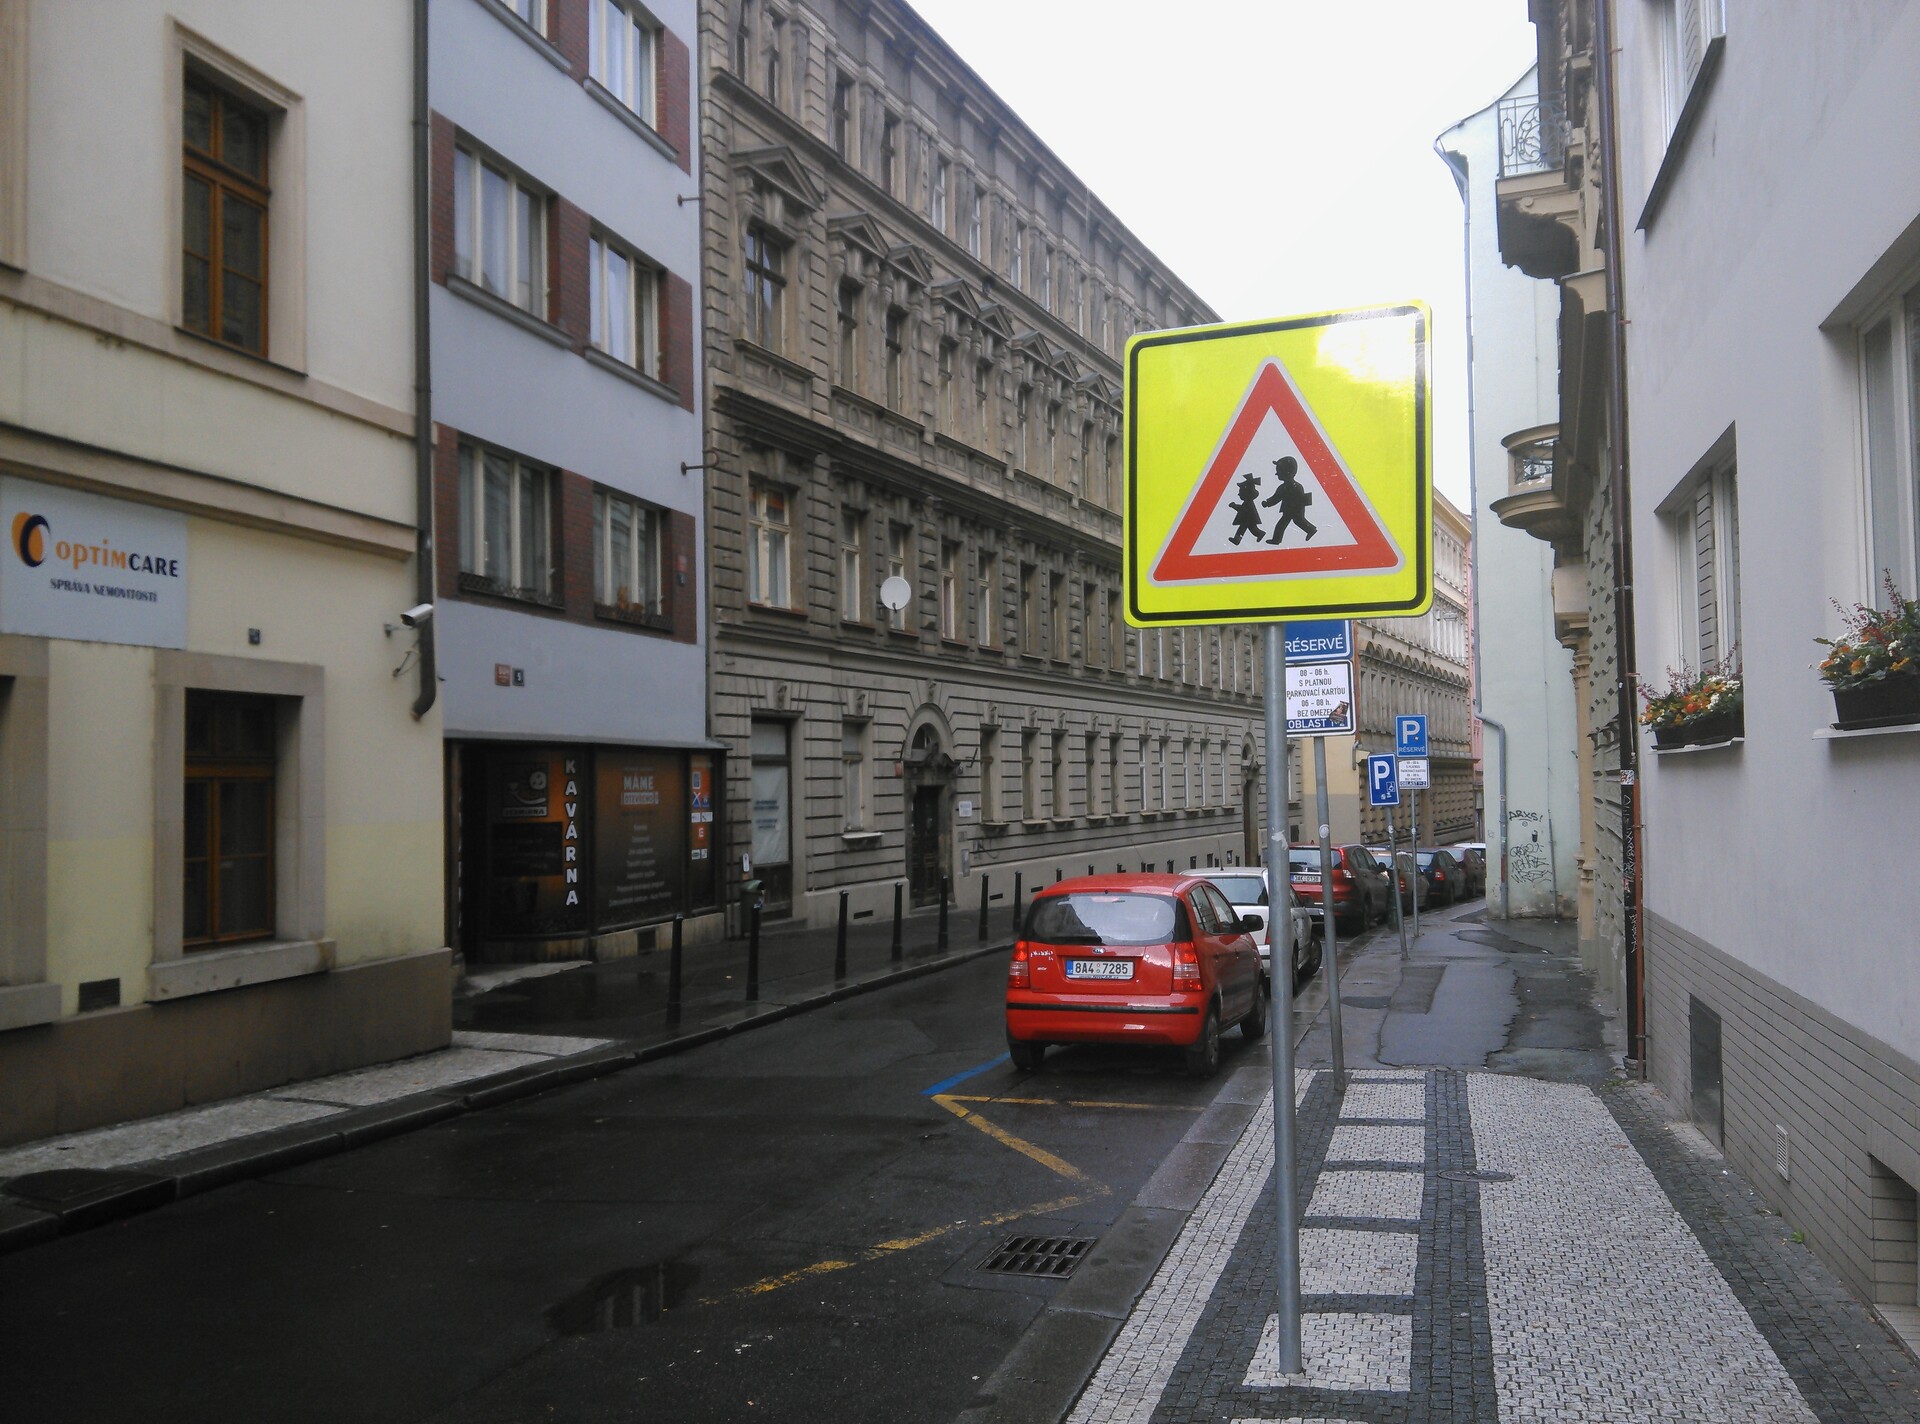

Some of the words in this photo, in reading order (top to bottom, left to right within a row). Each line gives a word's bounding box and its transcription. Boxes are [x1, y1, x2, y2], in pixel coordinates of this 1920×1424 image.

[1285, 634, 1344, 653] RÉSERVÉ
[1300, 669, 1308, 677] 08
[1298, 679, 1304, 688] S
[1304, 678, 1332, 687] PLATNOU
[1286, 687, 1320, 698] PARKOVACÍ
[1321, 687, 1346, 696] KARTOU
[1297, 709, 1309, 717] BEZ
[1288, 718, 1327, 729] OBLAST
[565, 759, 579, 906] KAVÁRNA
[1075, 962, 1095, 974] 8A4
[1102, 962, 1129, 975] 7285
